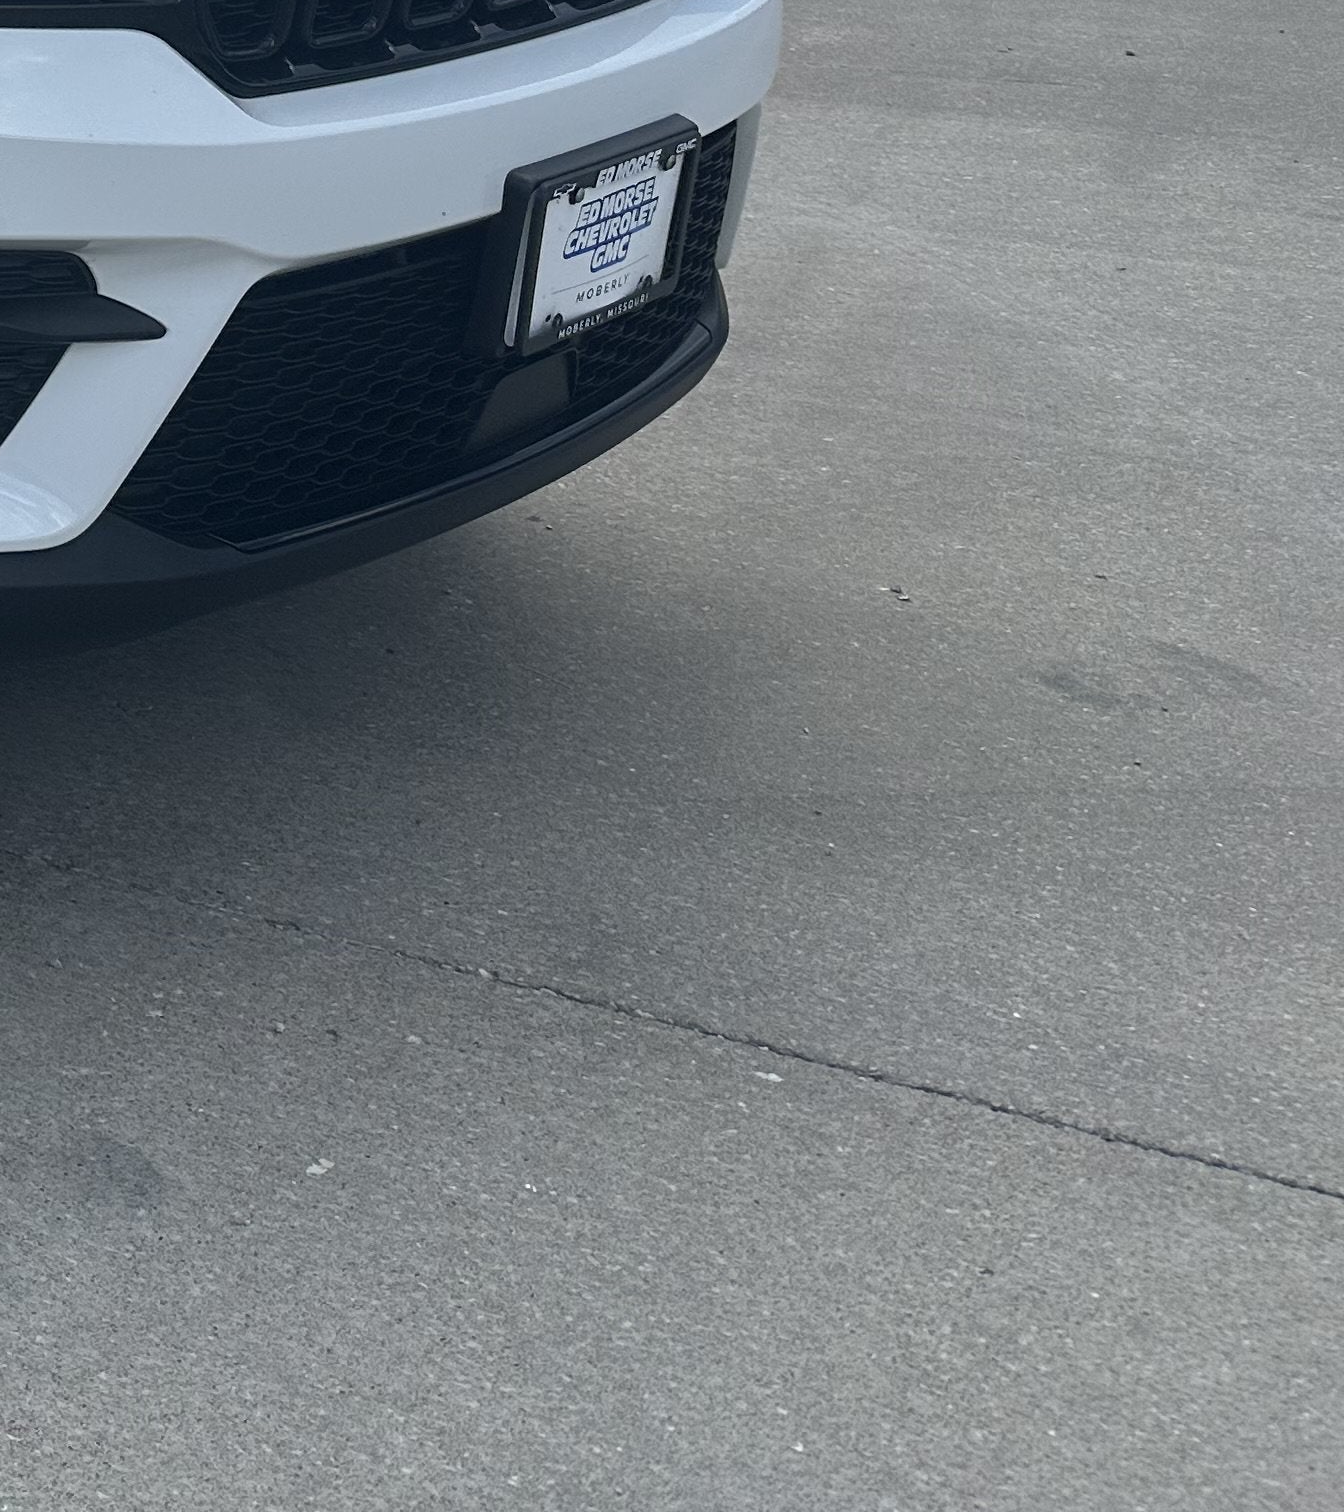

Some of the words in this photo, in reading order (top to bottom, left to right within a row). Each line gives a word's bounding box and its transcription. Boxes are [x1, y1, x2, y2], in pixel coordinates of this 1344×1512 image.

[675, 138, 697, 154] GMC
[596, 166, 616, 187] ED
[614, 149, 663, 180] MORSE
[576, 199, 602, 229] ED
[600, 176, 656, 220] MORSE
[563, 196, 659, 259] CHEVROLET
[590, 234, 631, 273] GMC
[576, 273, 630, 303] MOBERLY
[607, 293, 649, 319] MISSOURI
